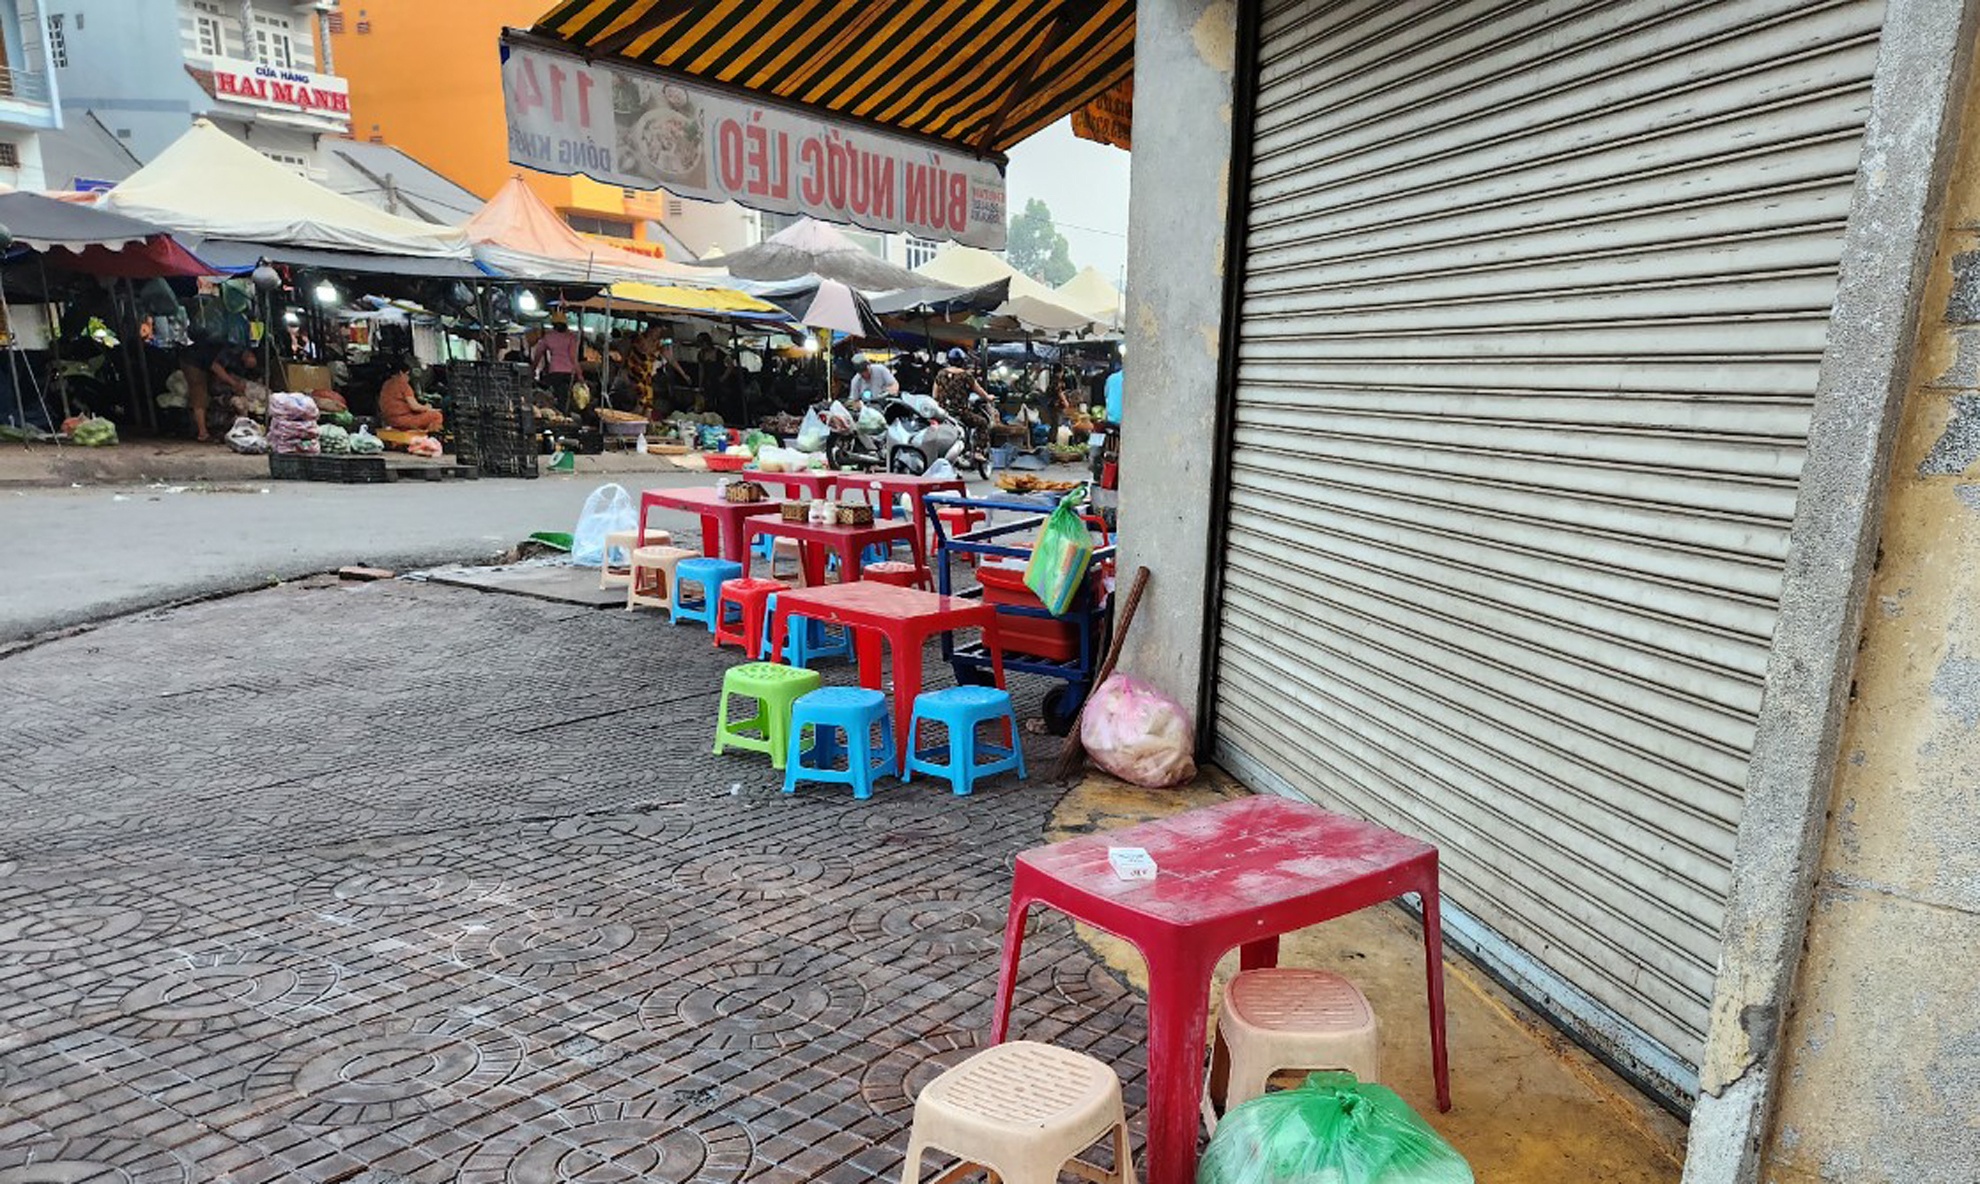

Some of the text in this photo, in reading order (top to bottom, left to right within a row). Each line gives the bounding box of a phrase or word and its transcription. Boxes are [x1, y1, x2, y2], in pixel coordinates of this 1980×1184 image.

[256, 65, 277, 78] CỬA
[217, 72, 348, 112] HAI MẠNH
